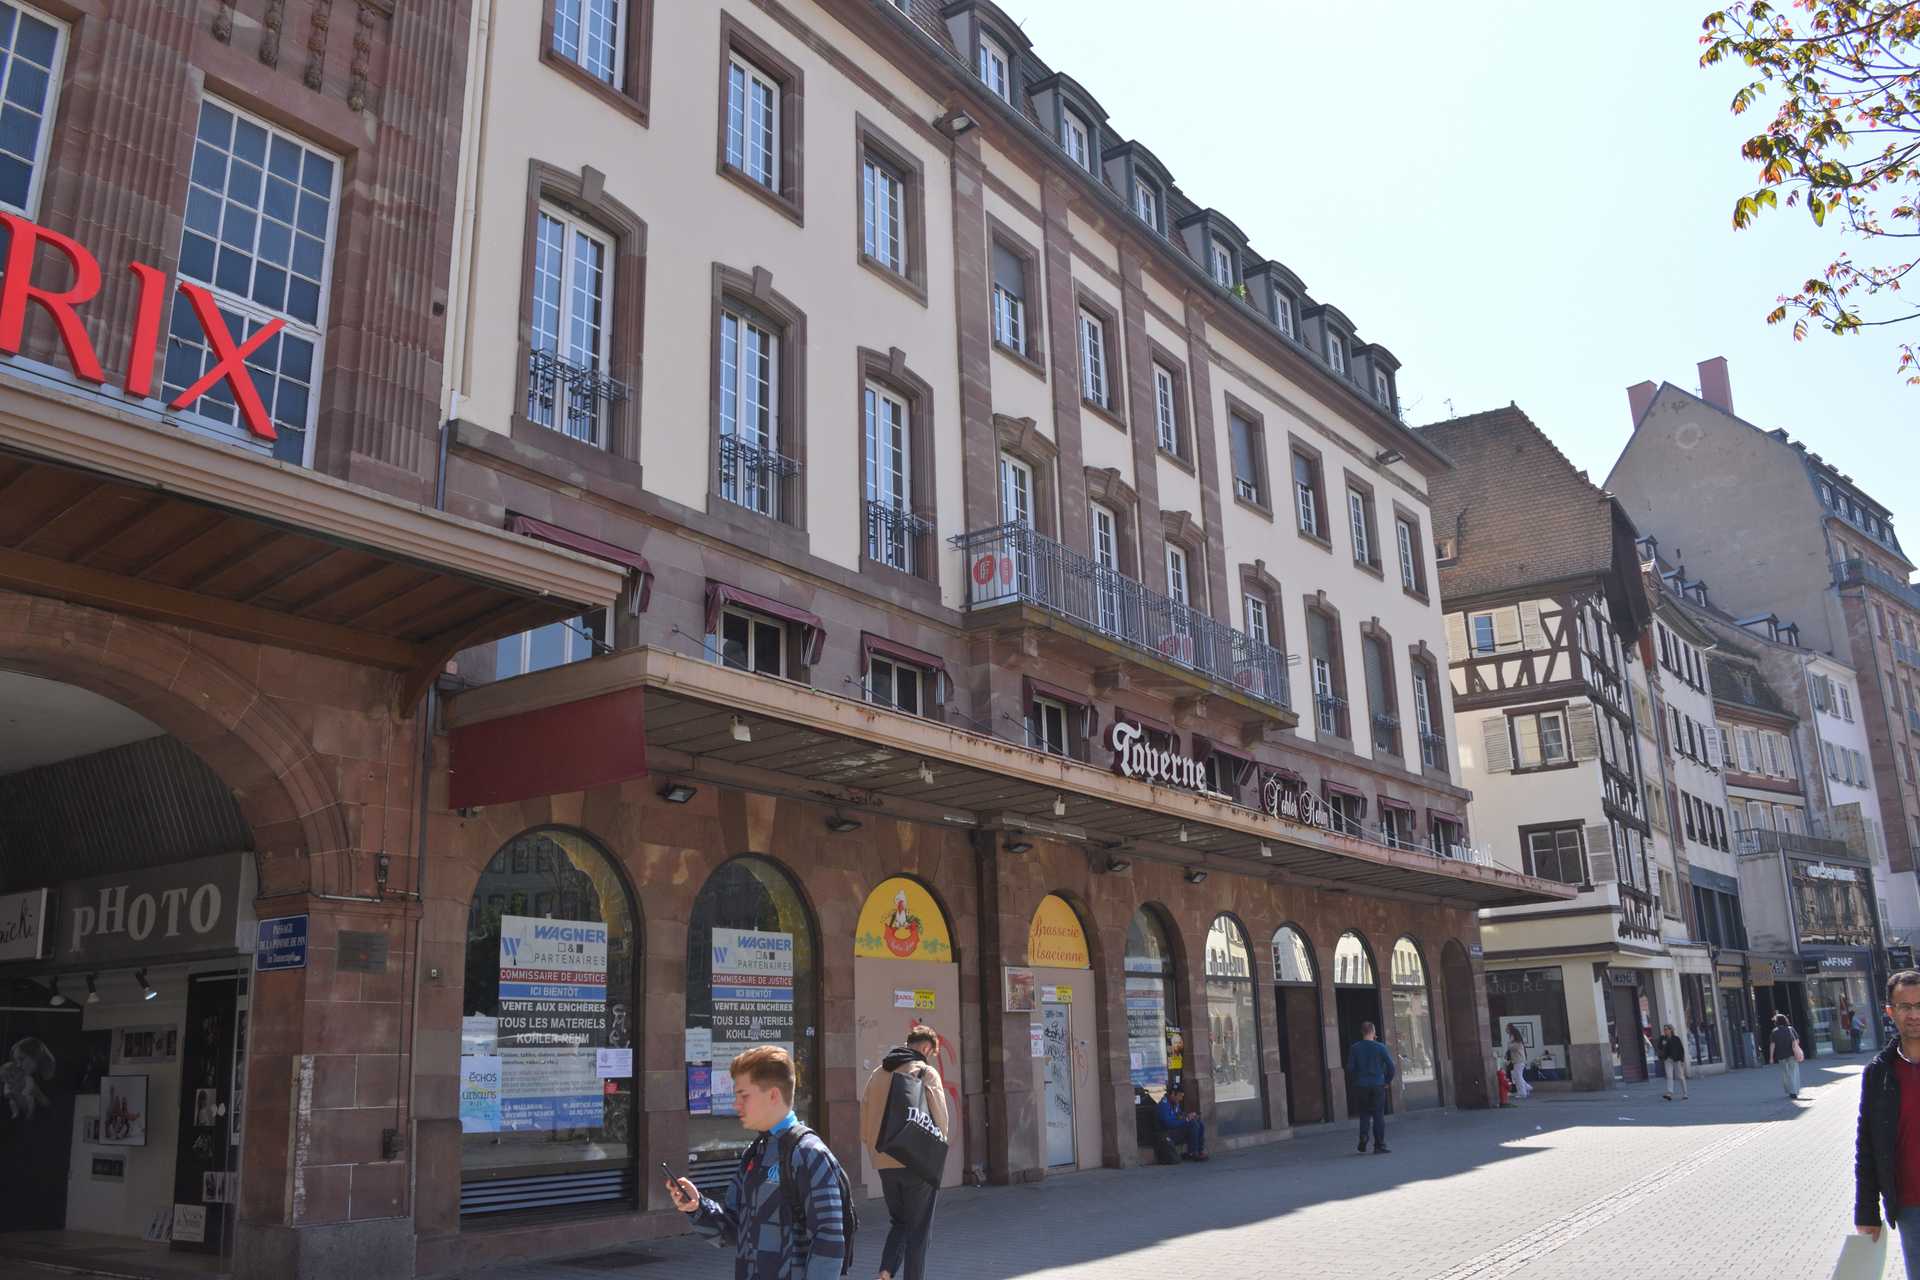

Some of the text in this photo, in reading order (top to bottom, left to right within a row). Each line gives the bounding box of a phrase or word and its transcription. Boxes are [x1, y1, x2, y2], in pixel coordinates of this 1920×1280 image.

[0, 212, 277, 440] RIX
[1112, 720, 1208, 791] Taverne
[1033, 916, 1079, 938] Brasserie
[534, 925, 606, 943] WAGNER
[738, 935, 792, 951] WAGNER
[534, 953, 606, 967] PARTENAIRES
[738, 960, 792, 971] PARTENAIRES
[501, 969, 606, 983] COMMISSAIRE DE JUSTICE
[712, 975, 793, 986] COMMISSAIRE DE JUSTICE
[530, 986, 541, 996] ICI
[502, 1001, 533, 1011] VENTE
[536, 1002, 556, 1011] AUX
[715, 1002, 738, 1011] VENTE
[740, 1003, 755, 1011] AUX
[499, 1017, 526, 1029] TOUS
[529, 1018, 548, 1028] LES
[713, 1015, 733, 1026] TOUS
[735, 1016, 750, 1026] LES
